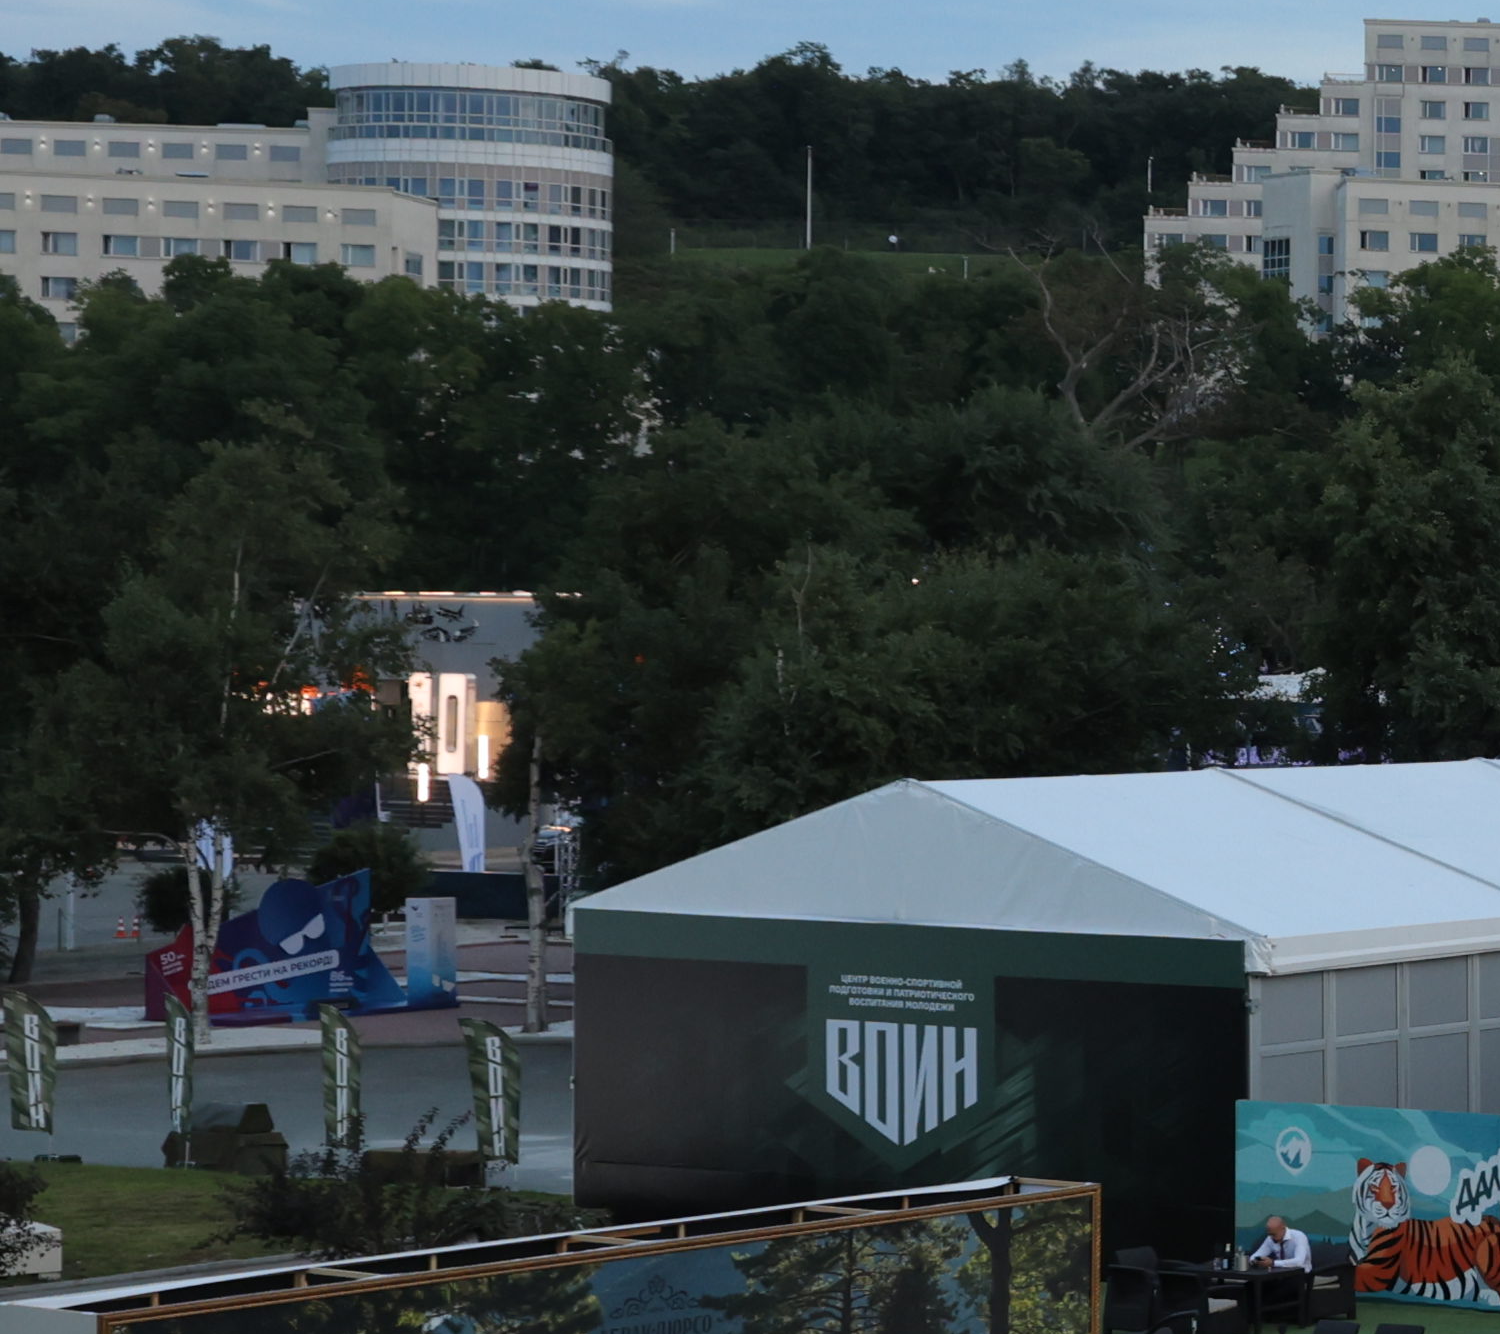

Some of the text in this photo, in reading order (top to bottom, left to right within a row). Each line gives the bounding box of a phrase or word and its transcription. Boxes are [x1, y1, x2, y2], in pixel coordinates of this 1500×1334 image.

[233, 969, 271, 984] ГРЕСТИ
[272, 964, 288, 976] НА
[290, 955, 334, 972] РЕКОРД!
[841, 974, 963, 989] ЦЕНТР ВОЕННО-СПОРТИВНОЙ
[829, 985, 975, 1002] ПОДГОТОВКИ И ПАТРИОТИЧЕСКОГО
[848, 997, 904, 1008] ВОСПИТАНИЯ
[23, 1013, 46, 1129] ВОИН
[825, 1019, 978, 1146] ВОИН
[485, 1036, 507, 1157] ВОИН
